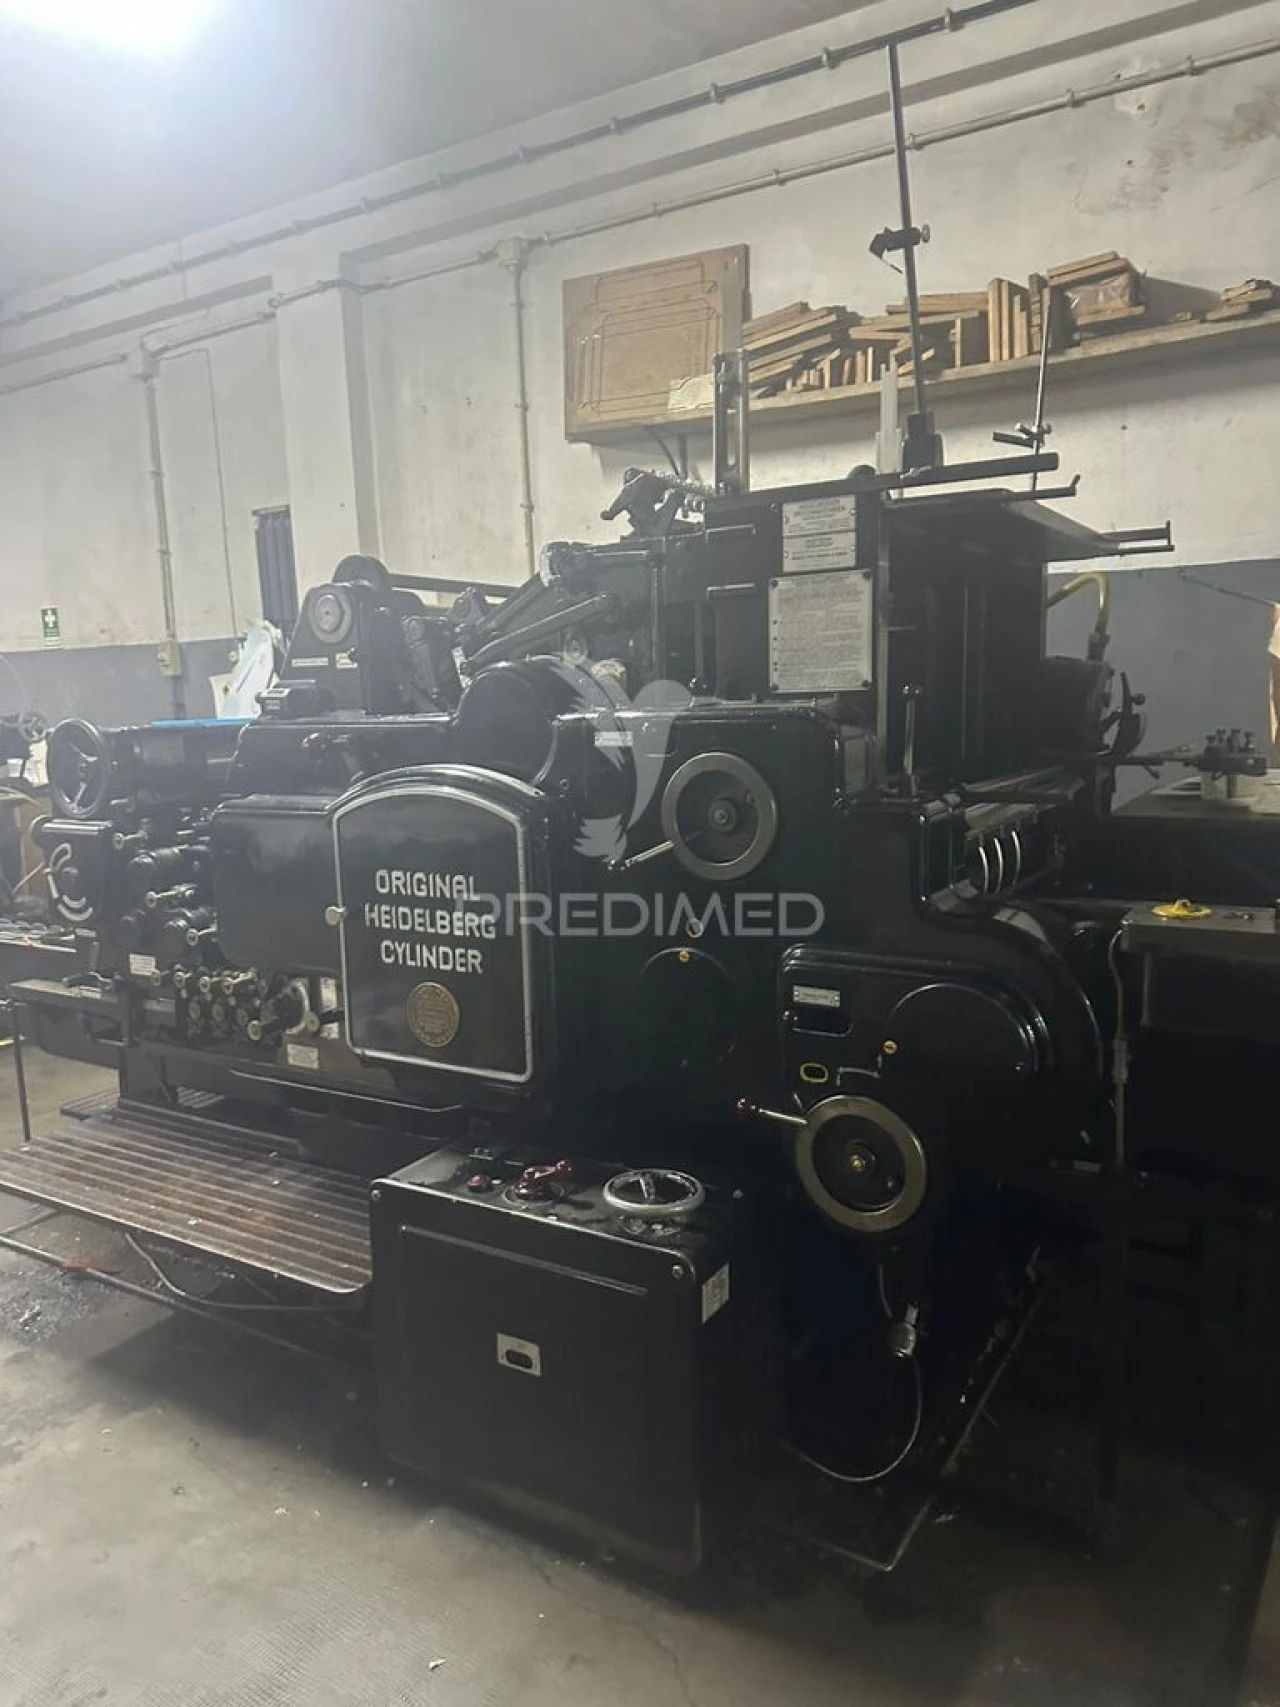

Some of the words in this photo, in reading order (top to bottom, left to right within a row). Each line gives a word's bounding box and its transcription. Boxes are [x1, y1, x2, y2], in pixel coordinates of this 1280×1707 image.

[375, 869, 481, 900] ORIGINAL
[364, 902, 496, 939] HEIDELBERG
[380, 939, 483, 974] CYLINDER
